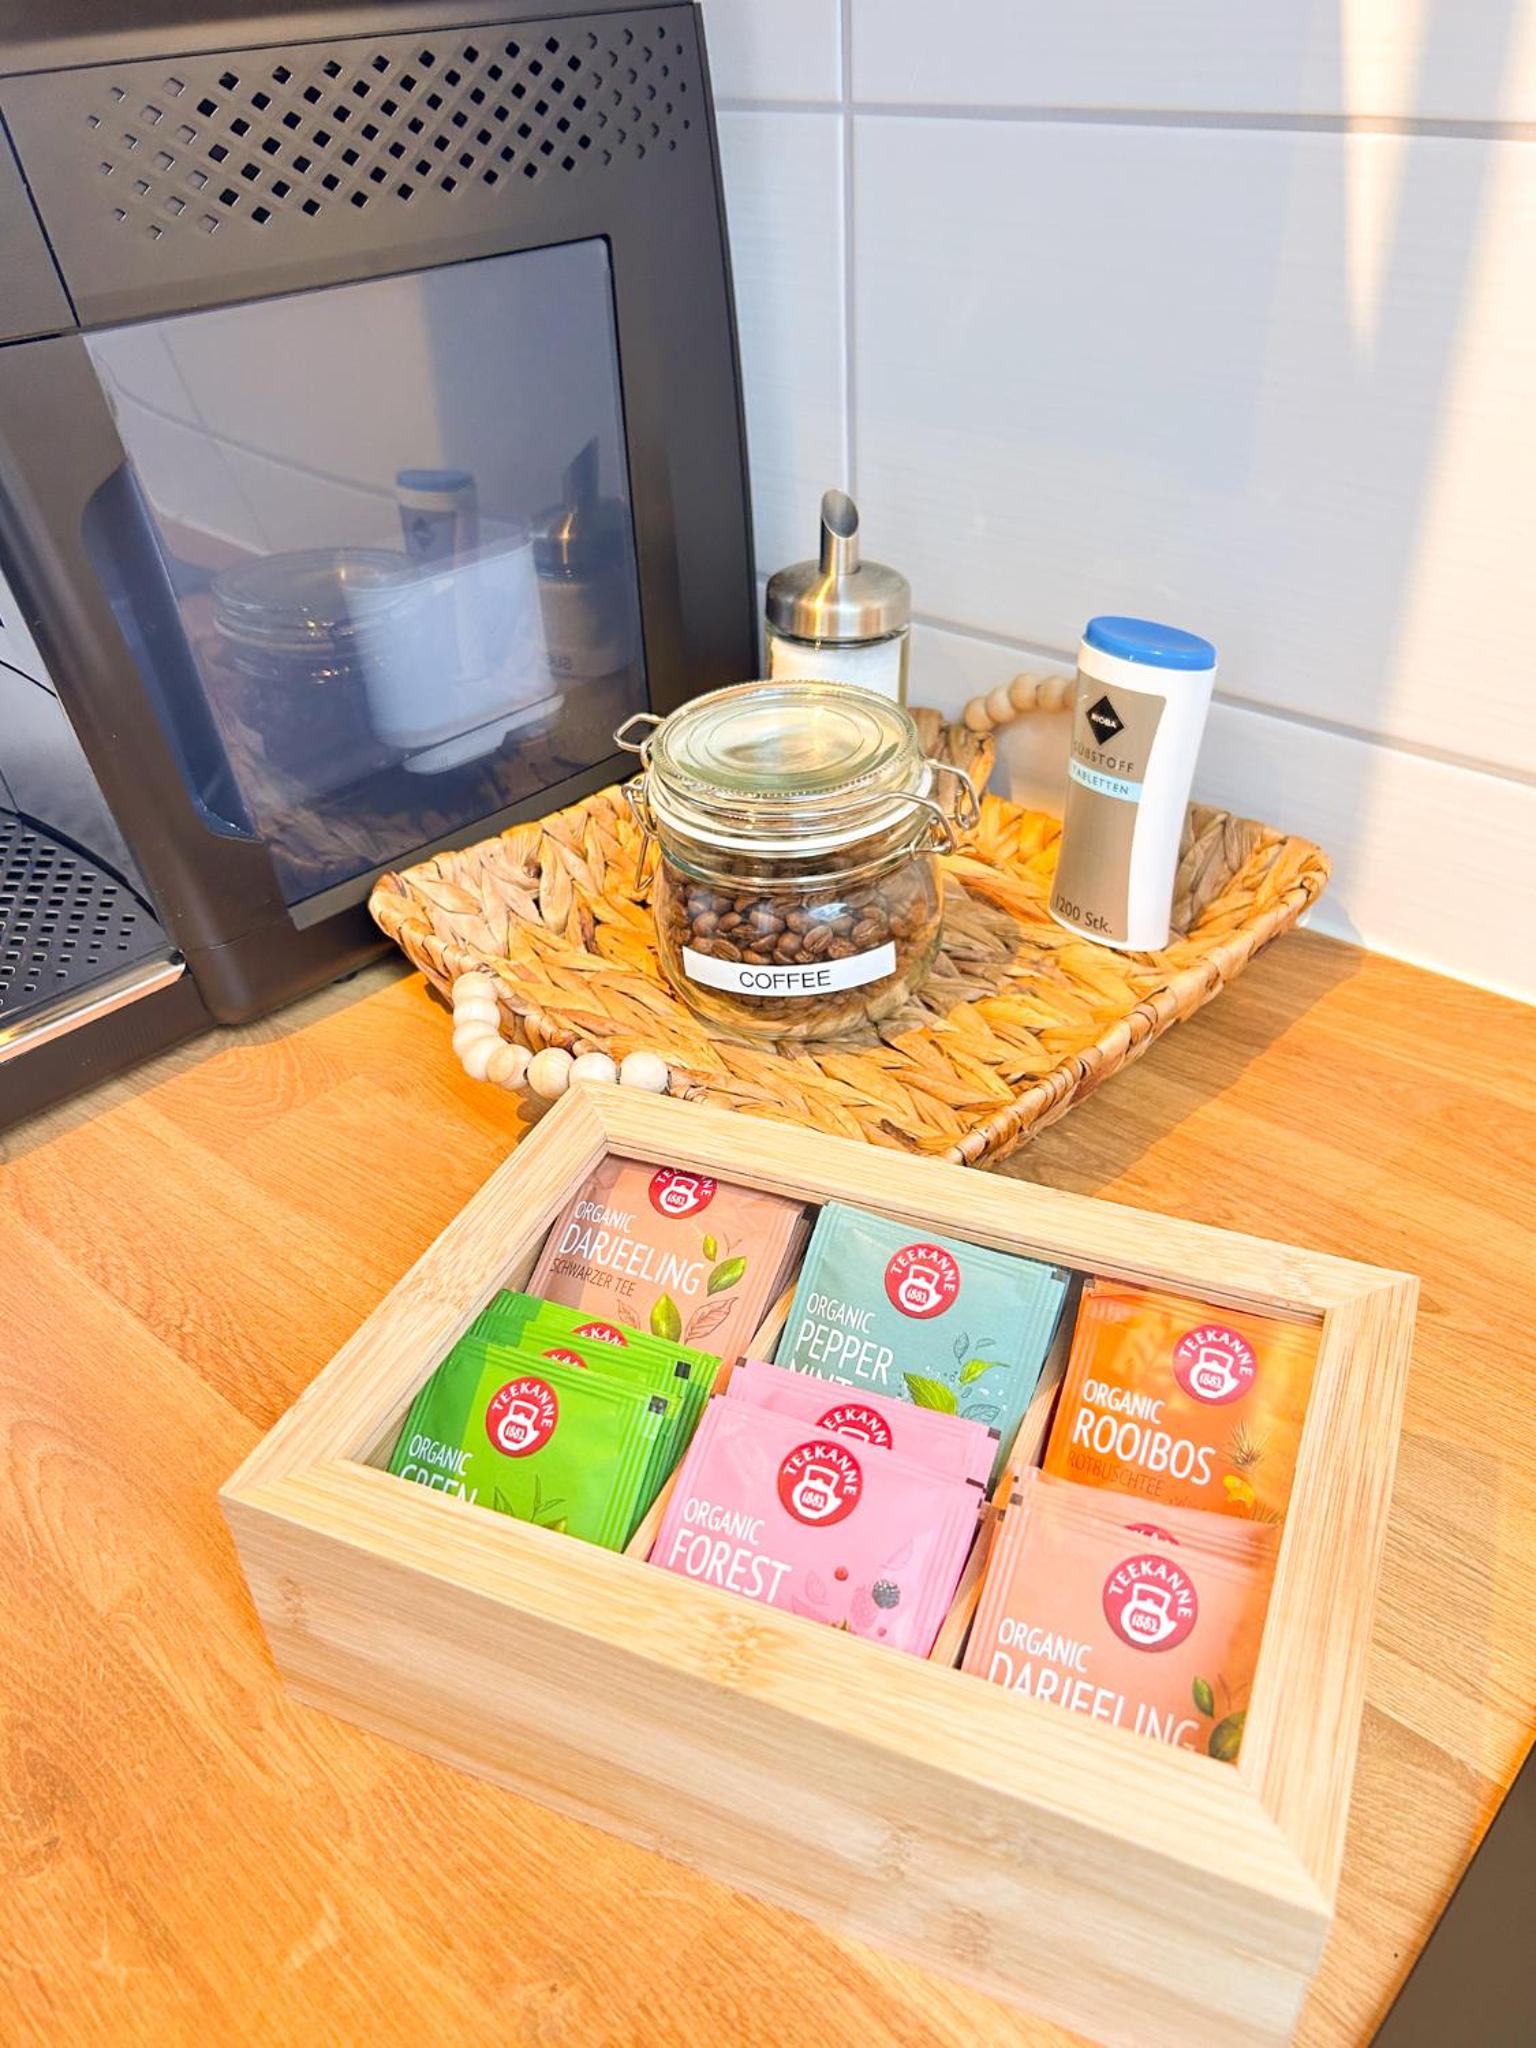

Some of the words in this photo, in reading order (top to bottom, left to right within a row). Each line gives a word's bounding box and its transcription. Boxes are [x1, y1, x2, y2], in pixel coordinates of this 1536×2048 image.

[1056, 894, 1081, 921] 1200
[1085, 911, 1113, 934] Stk.
[739, 969, 831, 989] COFFEE
[574, 1200, 637, 1233] ORGANIC
[550, 1257, 613, 1291] SCHWARZER
[614, 1277, 637, 1298] TEE
[558, 1223, 704, 1296] DARJEELING
[890, 1248, 956, 1292] TEEKANNE
[806, 1293, 876, 1334] ORGANIC
[795, 1320, 894, 1386] PEPPER
[1178, 1330, 1254, 1376] TEEKANNE
[491, 1382, 555, 1428] TEEKANNE
[1083, 1379, 1165, 1424] ORGANIC
[823, 1409, 888, 1443] EEKANN
[1072, 1407, 1216, 1486] ROOIBOS
[409, 1434, 473, 1476] ORGANIC
[783, 1445, 857, 1496] TEEKANNE
[1068, 1450, 1166, 1498] ROTBUSCHTEE
[683, 1497, 765, 1546] ORGANIC
[668, 1528, 792, 1604] FOREST
[1108, 1560, 1193, 1619] TEEKANNE
[998, 1617, 1092, 1673] ORGANIC
